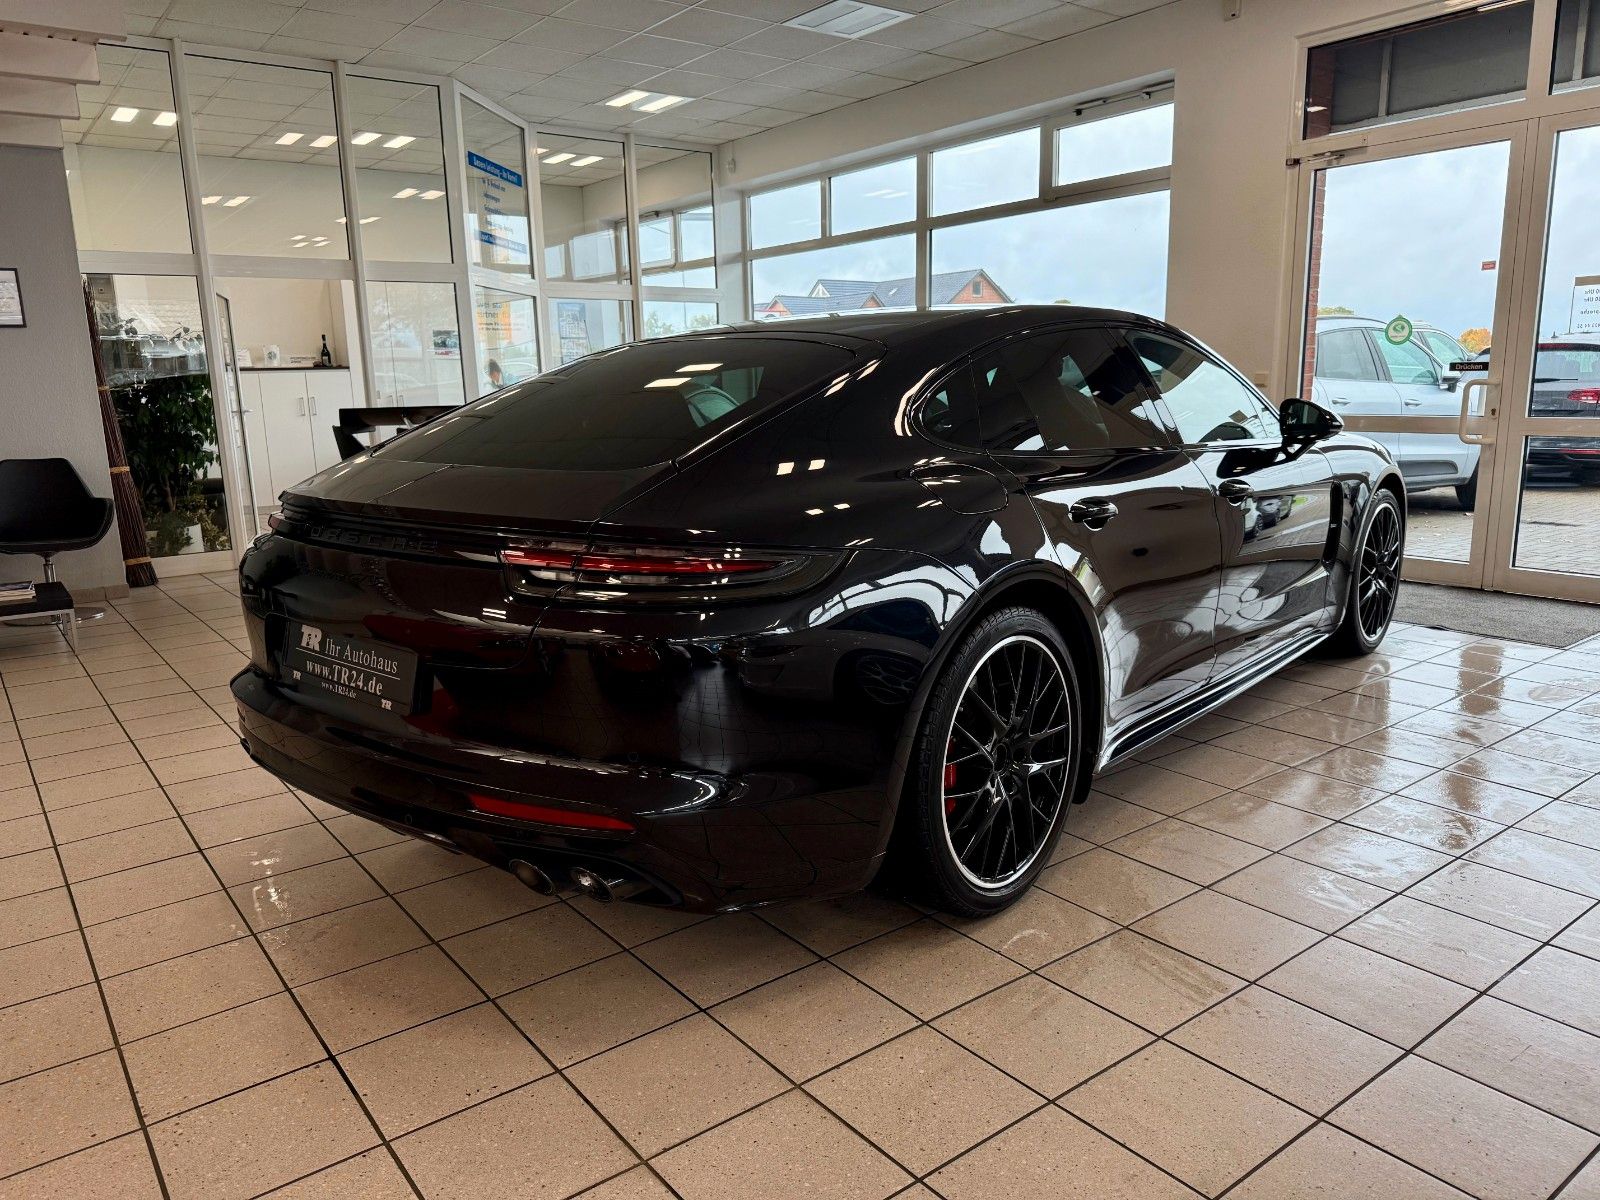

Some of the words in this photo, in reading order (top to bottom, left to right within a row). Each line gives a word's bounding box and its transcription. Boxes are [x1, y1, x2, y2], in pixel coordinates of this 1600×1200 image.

[325, 638, 340, 653] Ihr
[343, 644, 398, 674] Autohaus
[306, 660, 384, 696] www.TR24.de
[321, 681, 357, 699] www.TR24.de
